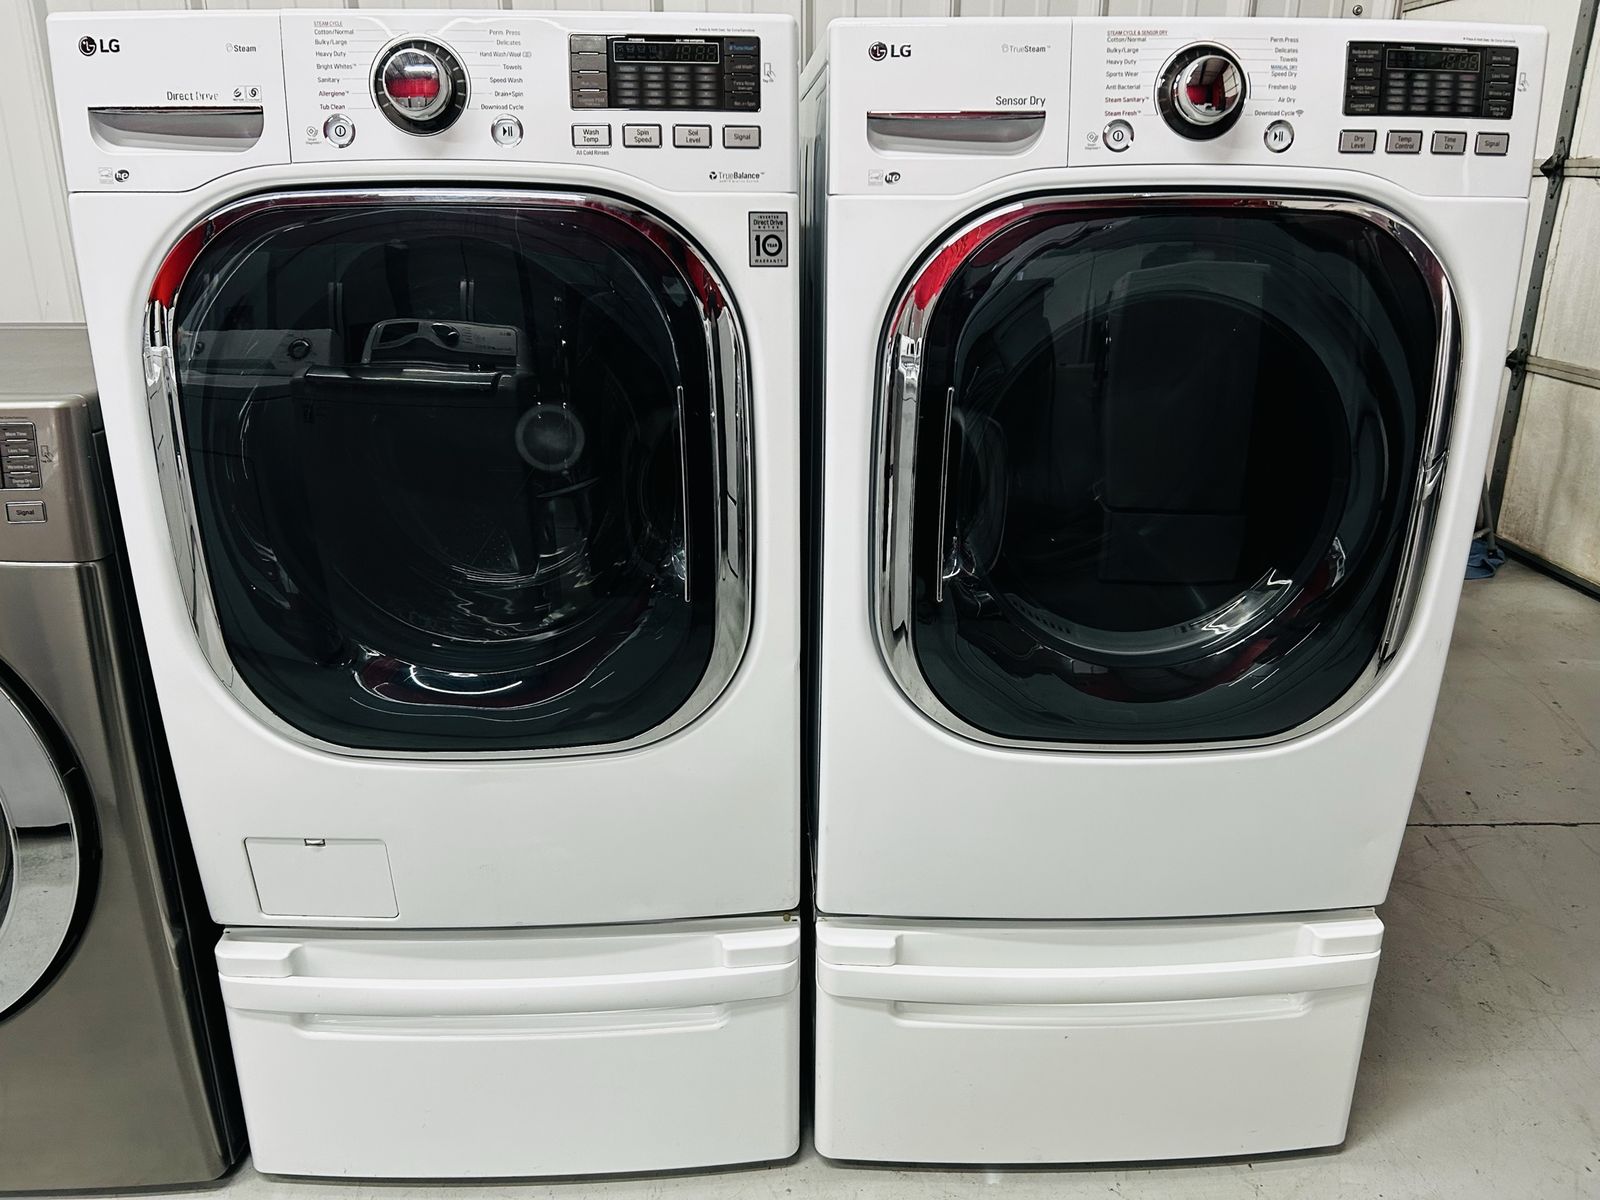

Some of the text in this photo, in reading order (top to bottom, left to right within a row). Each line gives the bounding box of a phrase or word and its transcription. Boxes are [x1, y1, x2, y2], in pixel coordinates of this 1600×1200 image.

[99, 38, 120, 53] LG
[314, 38, 347, 46] Bulky/Large
[233, 44, 257, 53] Steam
[890, 44, 911, 58] LG
[1009, 45, 1046, 53] TrueSteam
[316, 63, 333, 71] Bright
[166, 91, 194, 101] Direct
[995, 96, 1046, 108] Sensor Dry
[636, 129, 649, 137] Spin
[687, 129, 699, 137] Soil
[582, 136, 599, 144] Temp
[634, 136, 652, 145] Speed
[685, 136, 701, 144] Level
[734, 133, 751, 142] Signal
[1354, 135, 1364, 143] Dry
[1397, 135, 1412, 144] Temp
[1394, 142, 1415, 150] Control
[1444, 143, 1454, 151] Dry
[1484, 140, 1501, 148] Signal
[755, 234, 783, 257] 10
